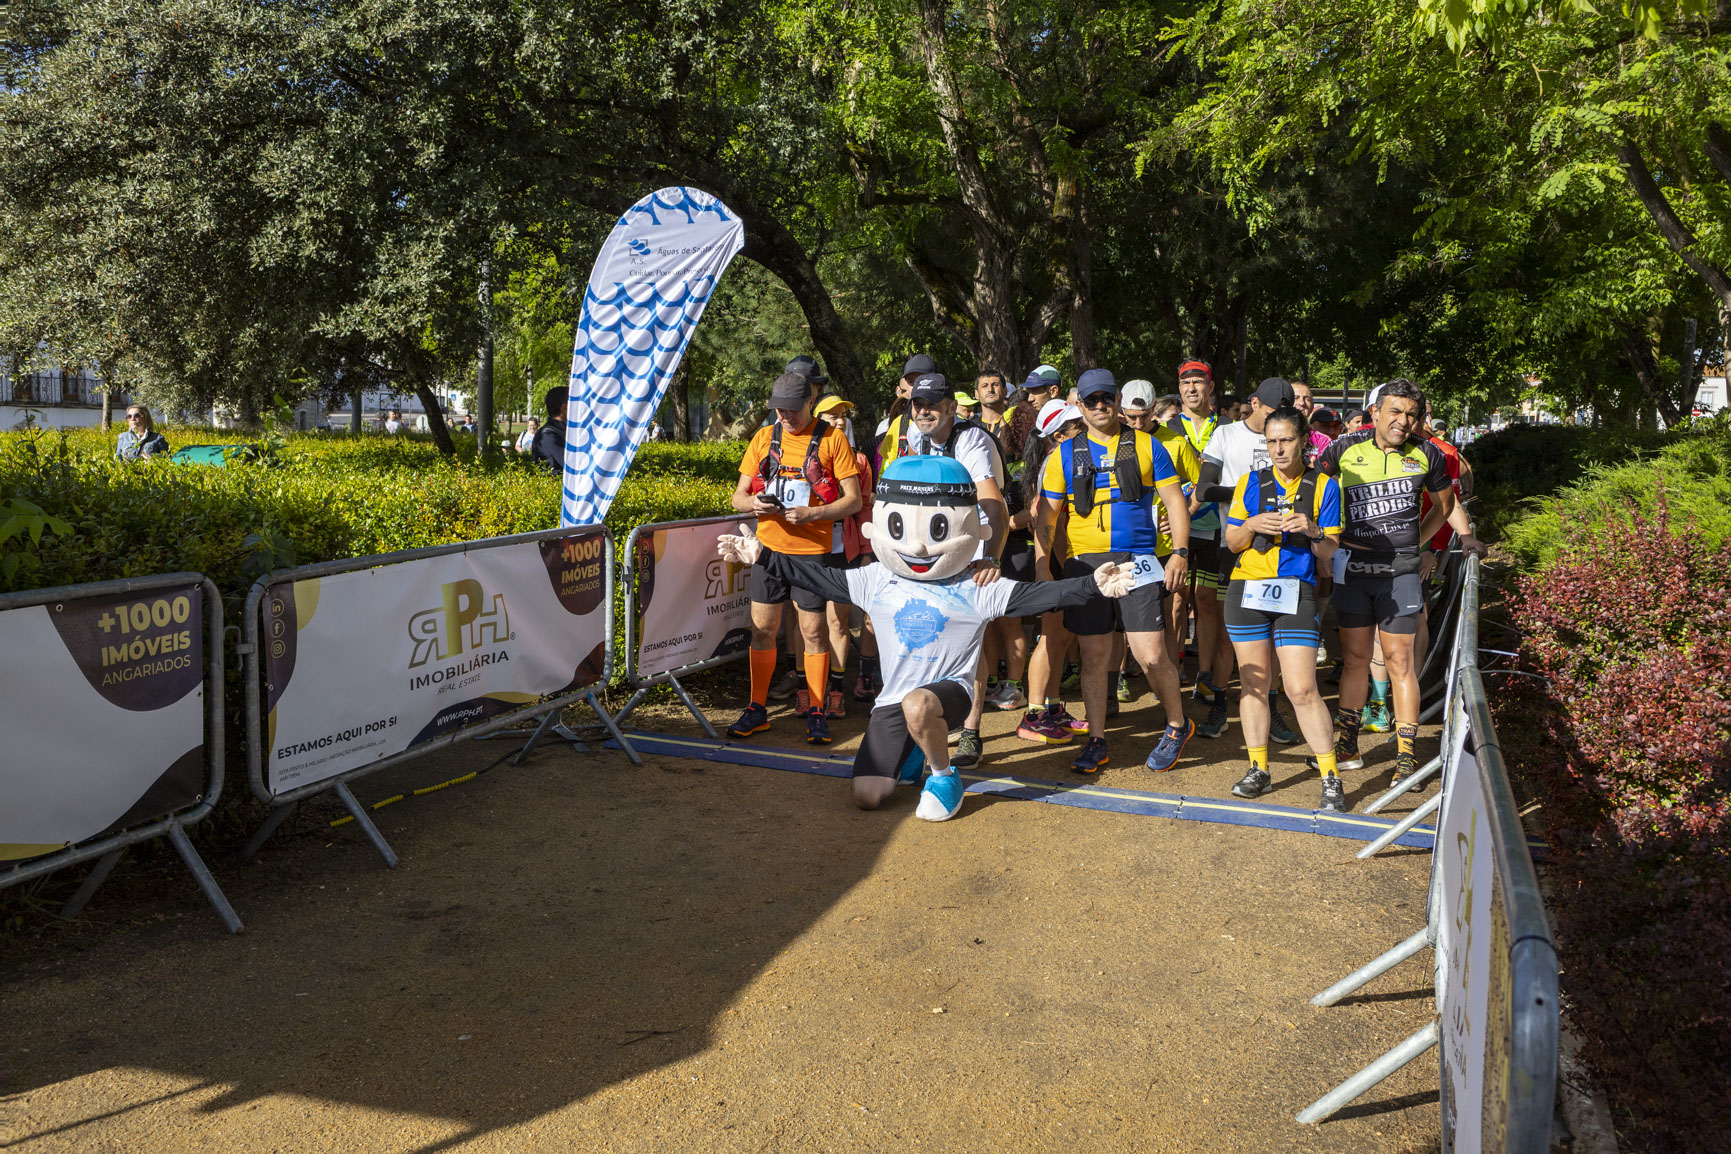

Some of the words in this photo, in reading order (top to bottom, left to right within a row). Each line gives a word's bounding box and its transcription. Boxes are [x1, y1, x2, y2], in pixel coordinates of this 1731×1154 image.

[657, 247, 679, 257] Águas
[1348, 480, 1413, 501] TRILHO
[561, 540, 600, 564] +1000
[562, 564, 600, 584] IMÓVEIS
[1134, 560, 1152, 574] 36
[561, 580, 600, 596] ANGARIADOS
[1262, 584, 1282, 600] 70
[98, 596, 190, 634] +1000
[102, 630, 191, 666] IMÓVEIS
[644, 640, 668, 654] ESTAMOS
[668, 636, 683, 646] AQUI
[684, 634, 698, 644] POR
[102, 654, 191, 686] ANGARIADOS
[410, 650, 510, 690] IMOBILIÁRIA
[438, 682, 457, 695] REAL
[458, 673, 482, 688] ESTATE
[436, 705, 484, 727] WWW.RPH.PT
[278, 735, 333, 760] ESTAMOS
[335, 726, 362, 744] AQUI
[365, 720, 386, 734] POR
[388, 716, 398, 726] SI
